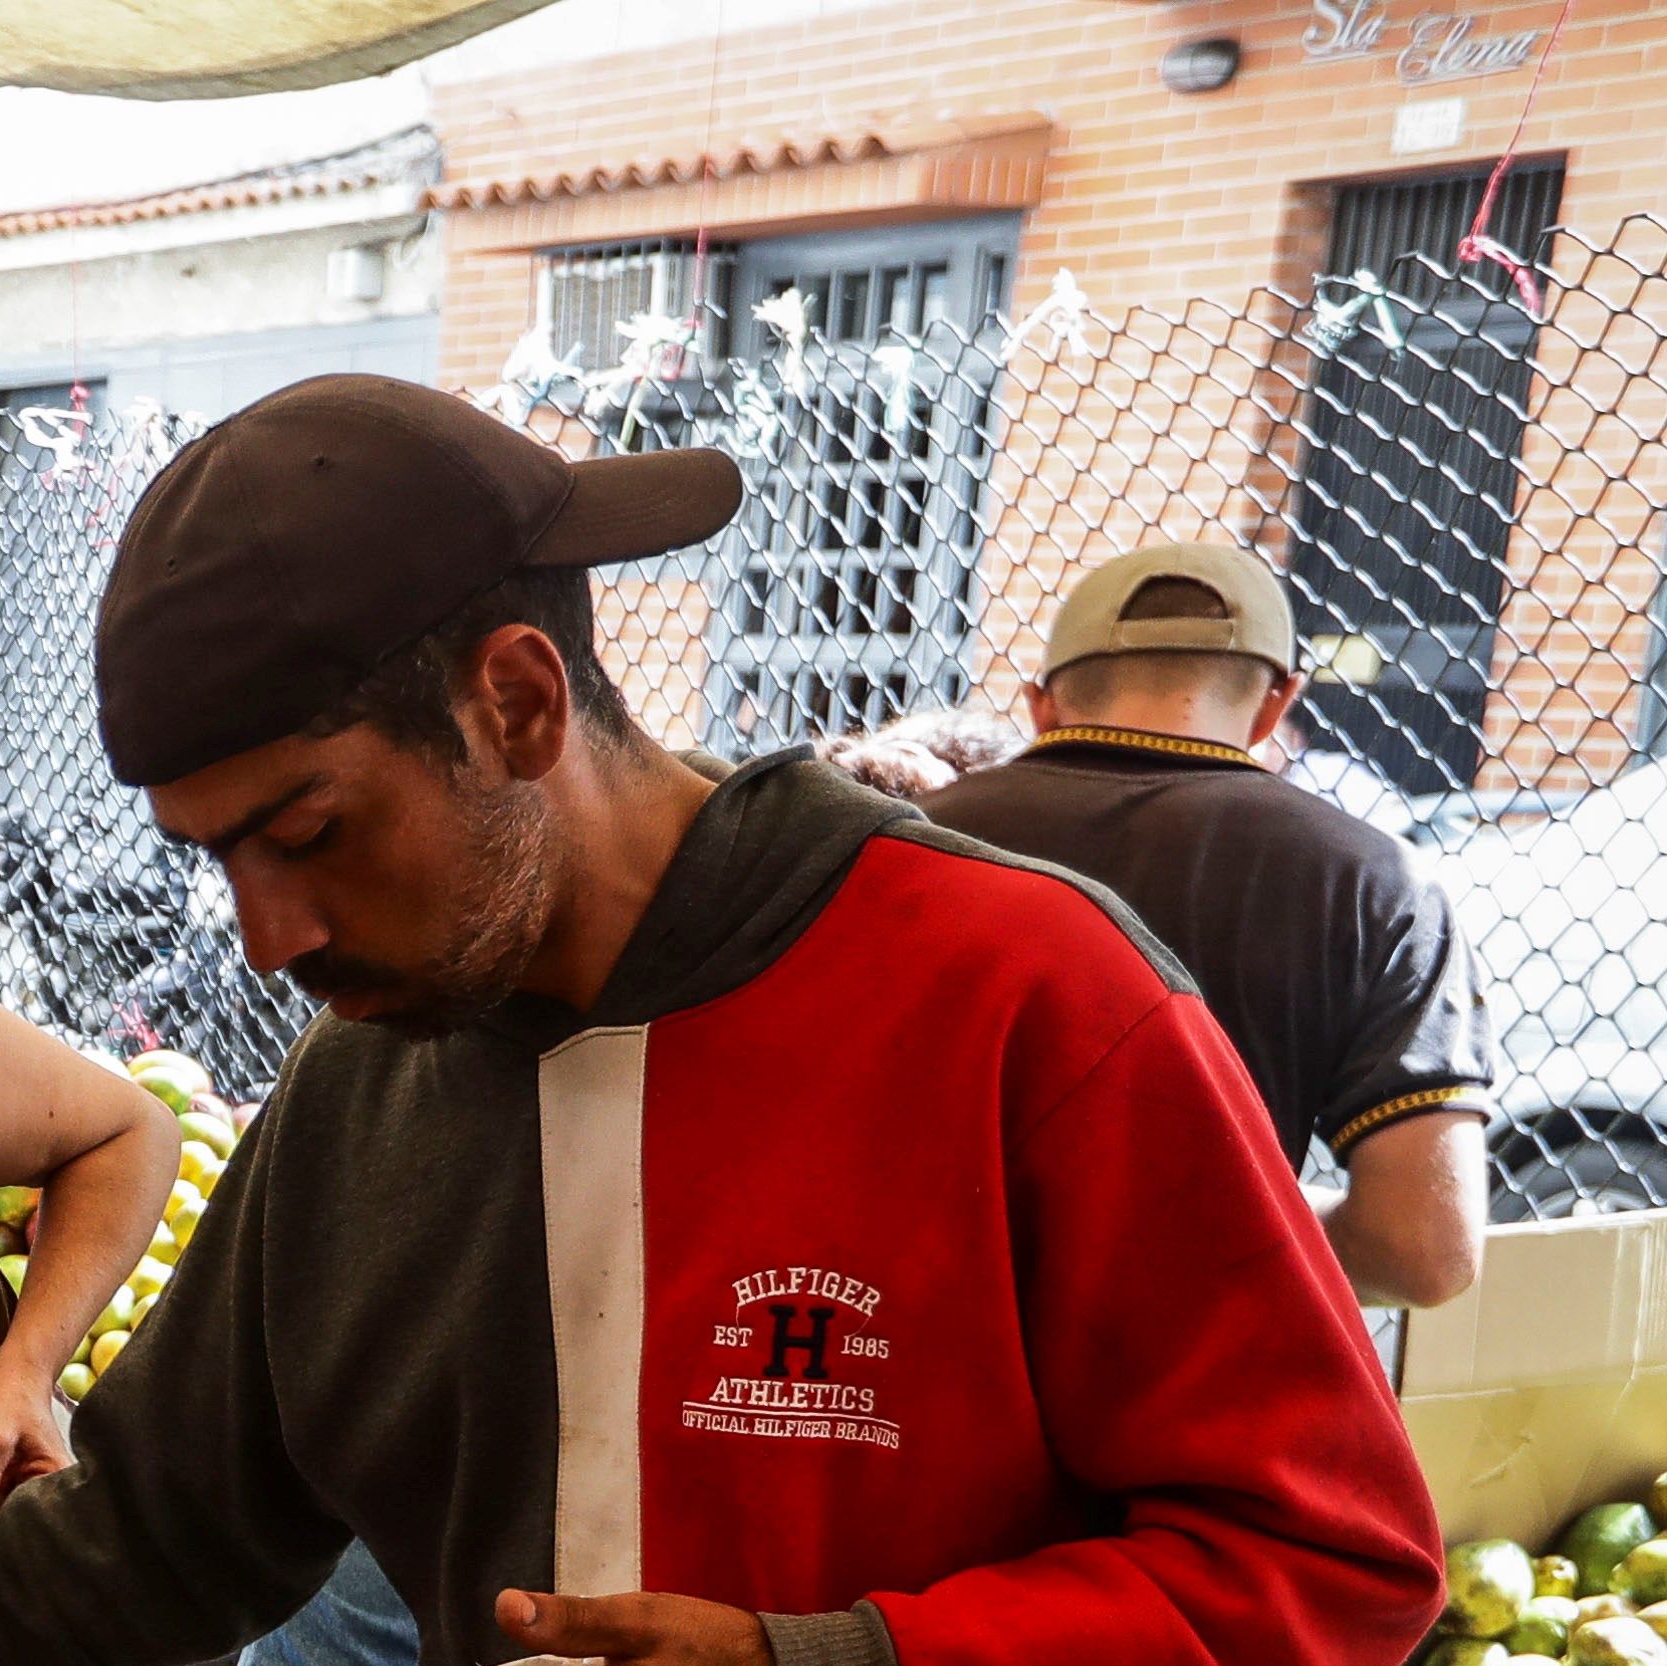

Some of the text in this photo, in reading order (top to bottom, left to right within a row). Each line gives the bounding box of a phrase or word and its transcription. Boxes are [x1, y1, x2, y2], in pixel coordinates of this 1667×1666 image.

[1396, 10, 1539, 82] Elena
[732, 1267, 881, 1316] HILFIGER
[713, 1304, 890, 1379] EST H 1985
[709, 1377, 875, 1413] ATHLETICS
[683, 1411, 900, 1449] OFFICIAL HILFIGER BRANDS
